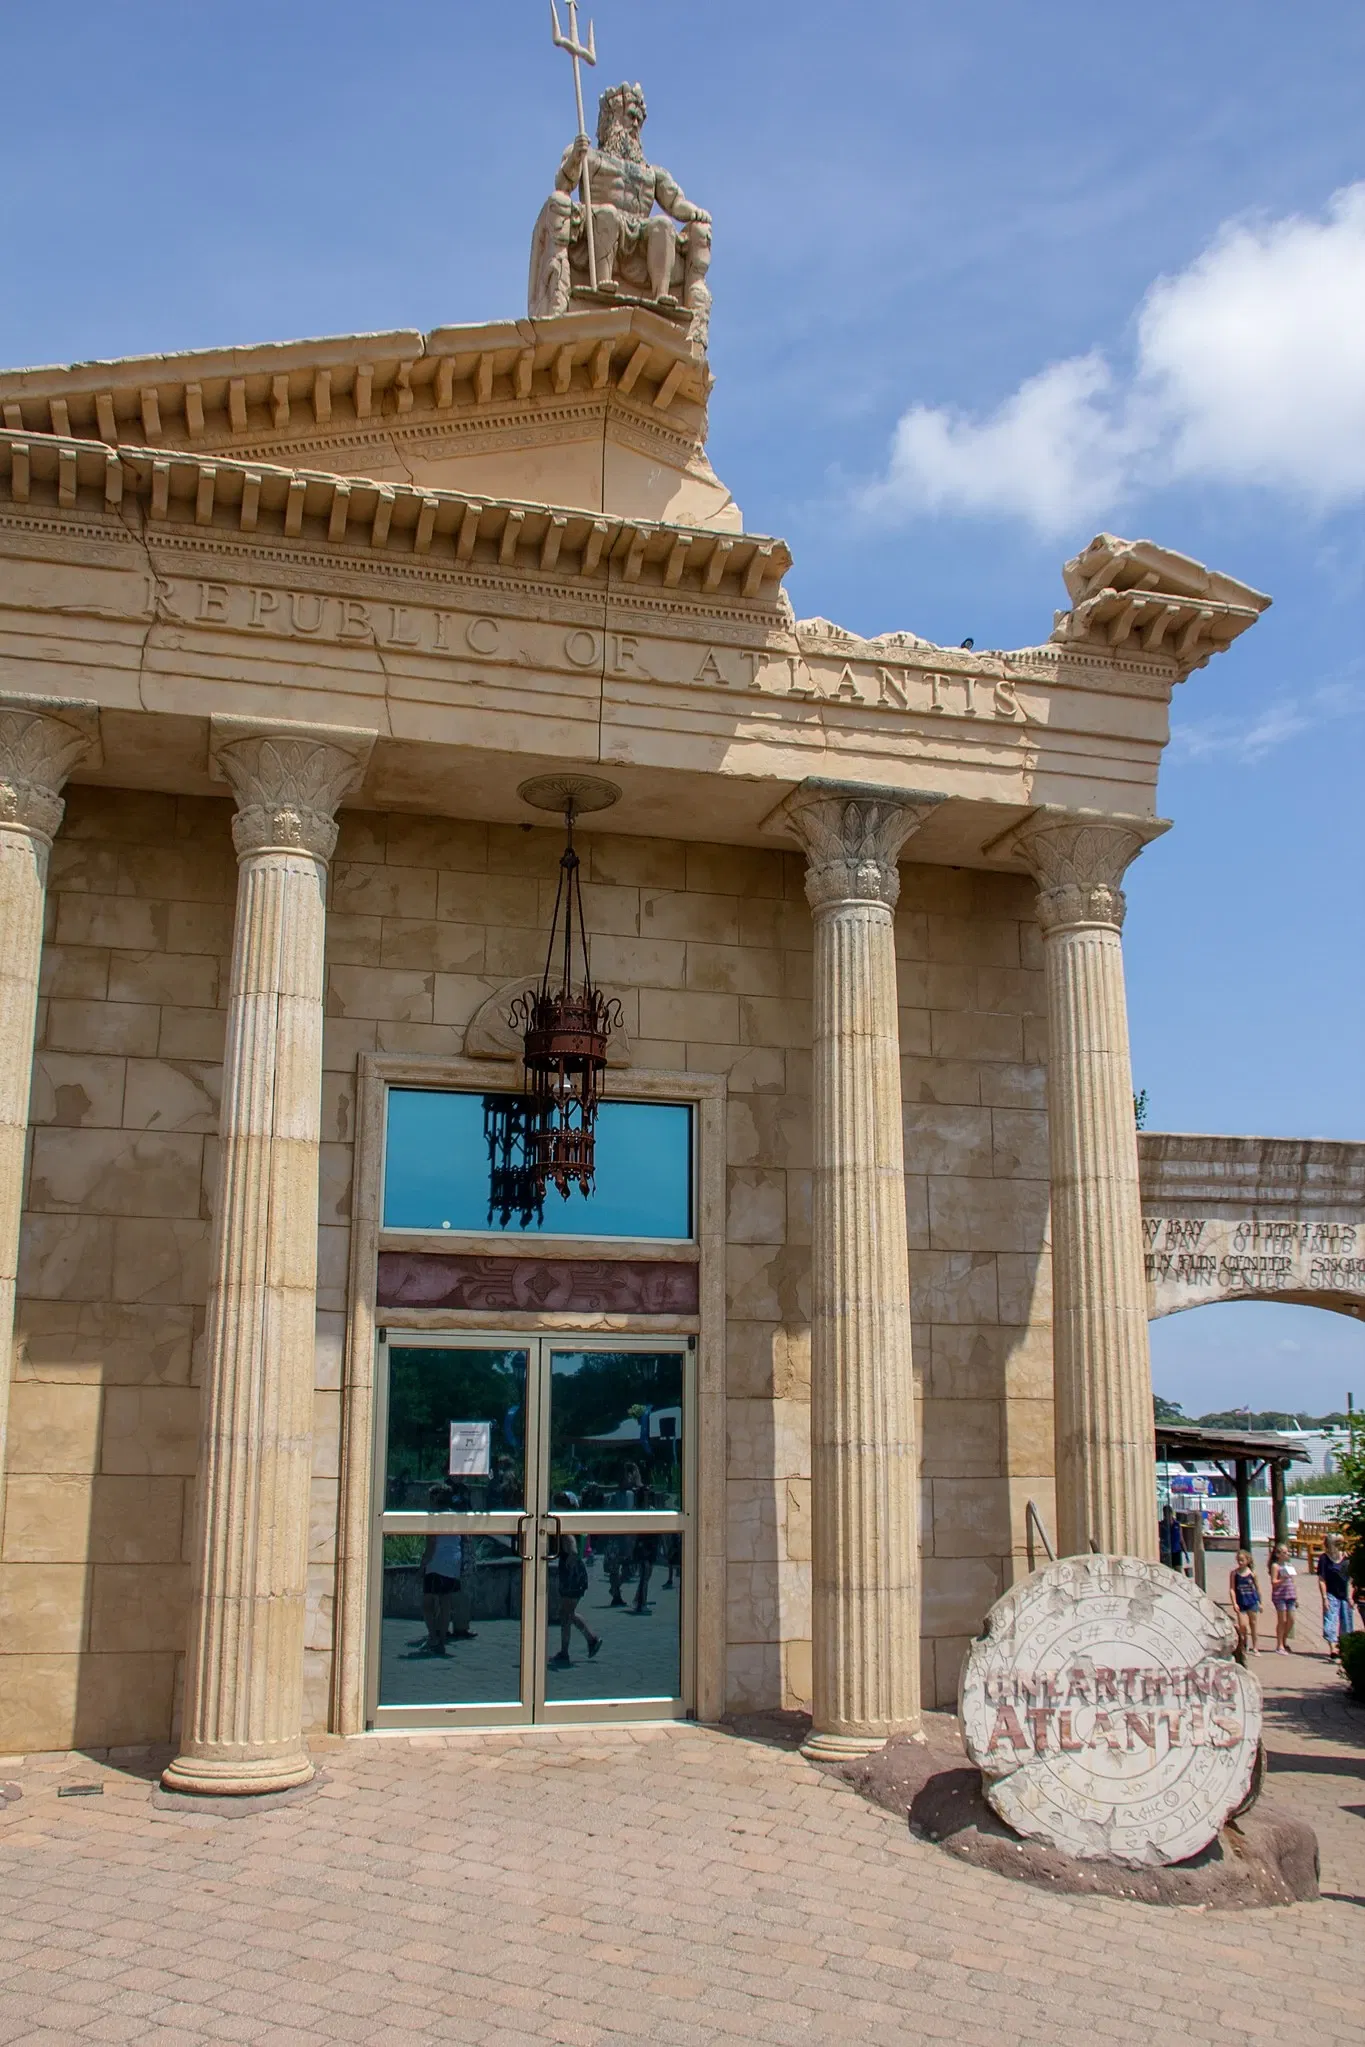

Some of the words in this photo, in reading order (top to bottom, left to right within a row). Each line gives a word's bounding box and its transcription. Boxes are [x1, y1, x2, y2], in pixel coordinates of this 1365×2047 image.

[141, 576, 500, 655] REPUBLIC
[564, 629, 641, 672] OF
[693, 646, 1019, 718] ATLANTIS
[1141, 1219, 1162, 1236] AY
[1166, 1219, 1206, 1236] BAY
[1238, 1221, 1298, 1239] OTTER
[1302, 1222, 1357, 1240] FALLS
[1178, 1253, 1216, 1270] FUN
[1221, 1254, 1292, 1271] CENTER
[984, 1666, 1238, 1704] UNEARTHING
[987, 1701, 1243, 1752] ATLANTIS
